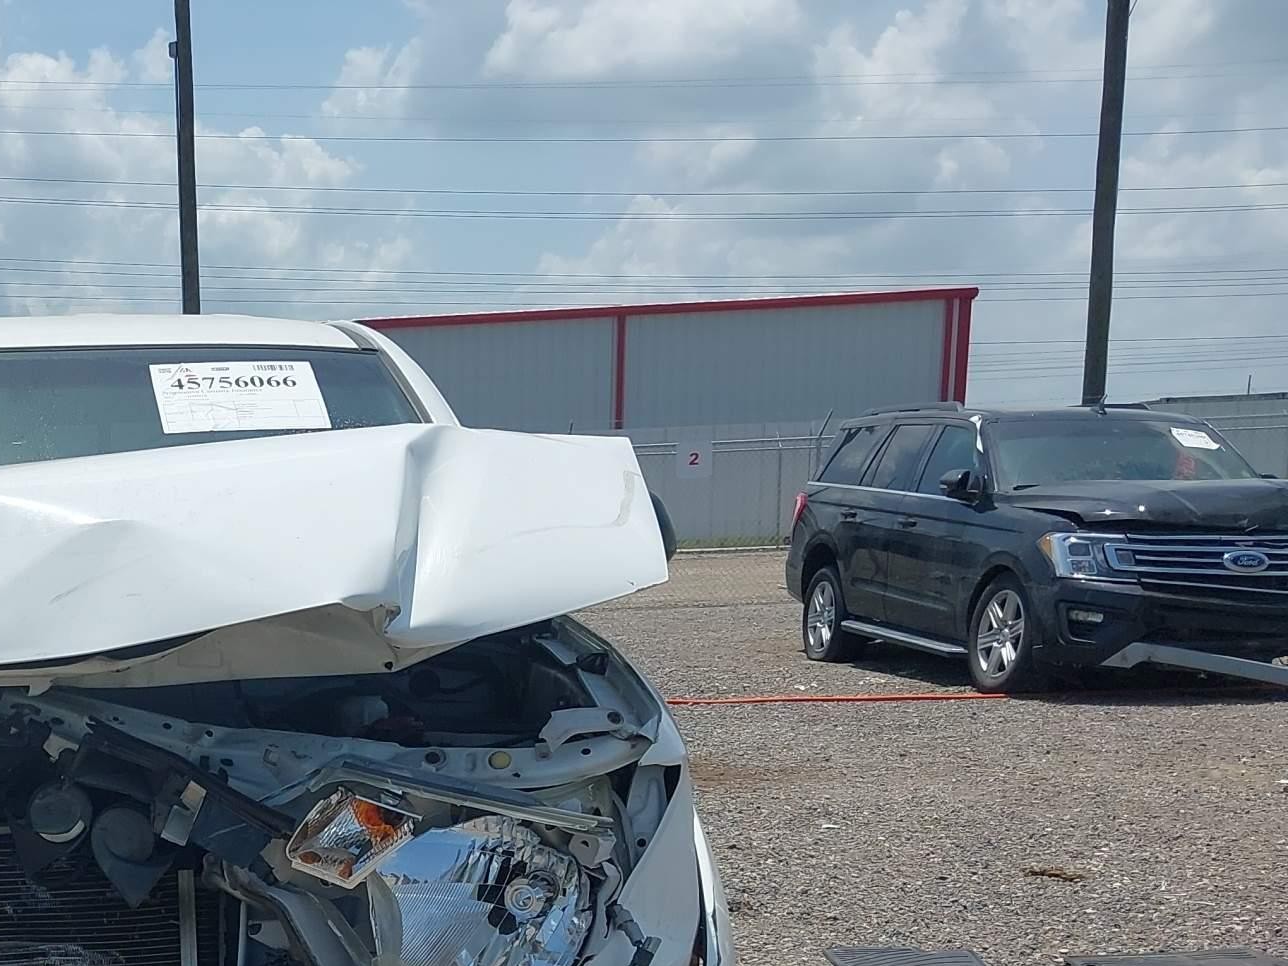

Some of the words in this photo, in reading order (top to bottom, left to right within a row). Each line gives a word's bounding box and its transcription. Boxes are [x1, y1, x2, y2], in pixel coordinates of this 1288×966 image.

[170, 375, 297, 390] 45756066
[689, 452, 700, 465] 2
[1237, 556, 1261, 566] Ford
